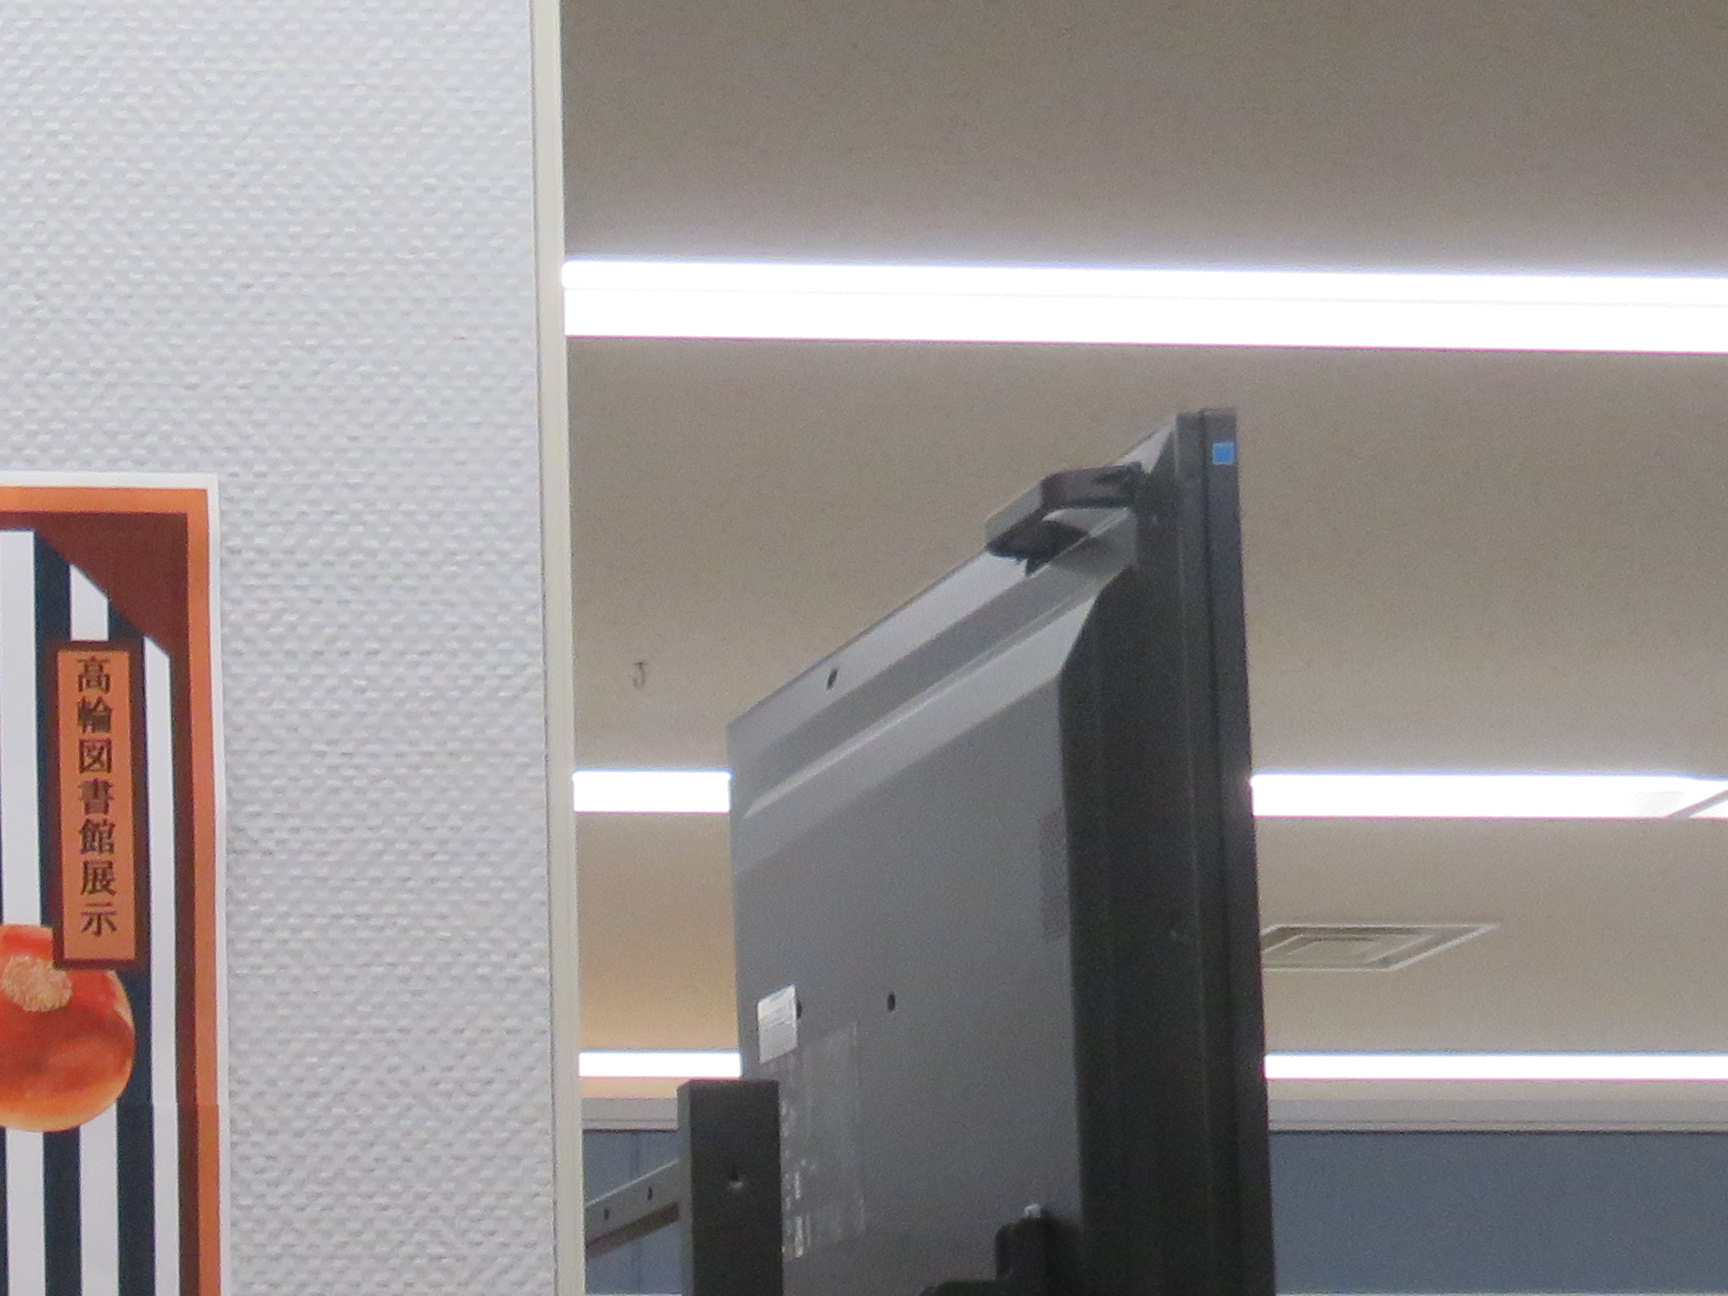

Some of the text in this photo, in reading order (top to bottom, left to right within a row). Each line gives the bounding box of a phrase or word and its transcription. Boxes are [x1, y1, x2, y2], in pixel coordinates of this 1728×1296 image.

[76, 656, 118, 937] 高輪図書館展示
